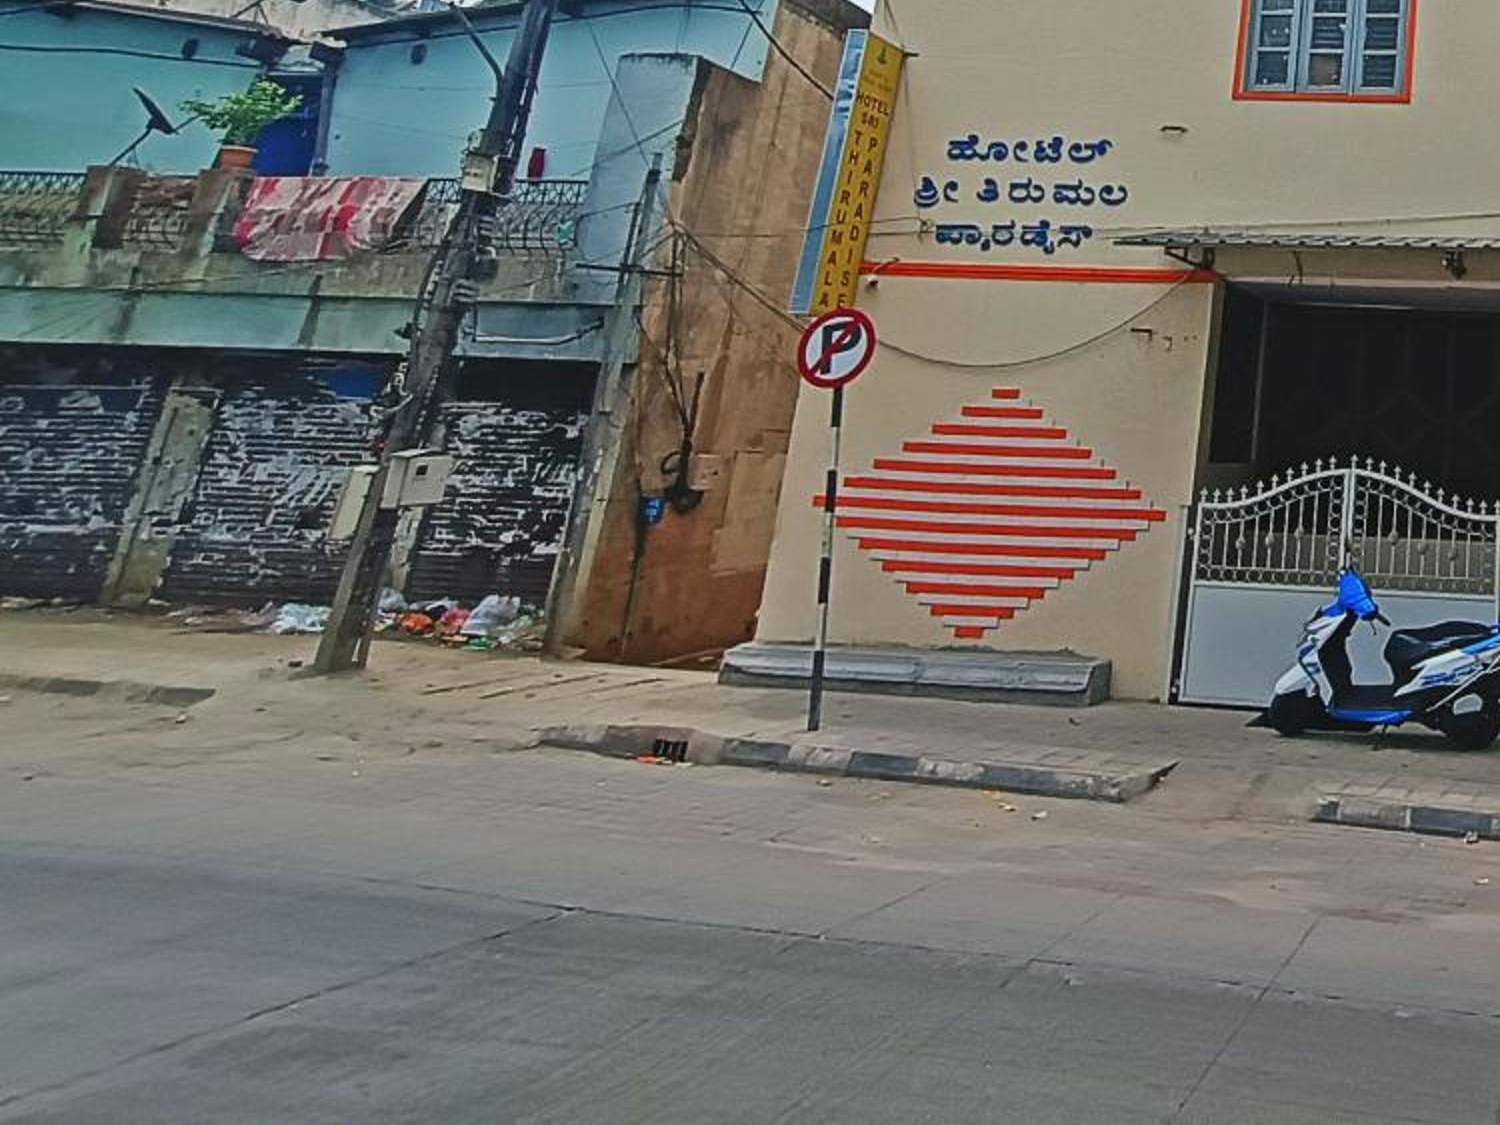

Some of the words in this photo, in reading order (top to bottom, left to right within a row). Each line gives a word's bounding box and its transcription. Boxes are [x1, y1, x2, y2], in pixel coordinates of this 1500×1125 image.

[855, 91, 890, 117] HOTEL
[861, 111, 880, 128] SRI
[946, 133, 1113, 164] ಹೋಟೆಲ್
[914, 176, 960, 208] ಶ್ರೀ
[976, 177, 1129, 207] ತಿರುಮಲ
[818, 130, 863, 308] THIRUMALA
[836, 137, 880, 309] PARADISE
[935, 219, 1093, 255] ಪ್ಯಾರಡೈಸ್
[820, 321, 862, 375] P
